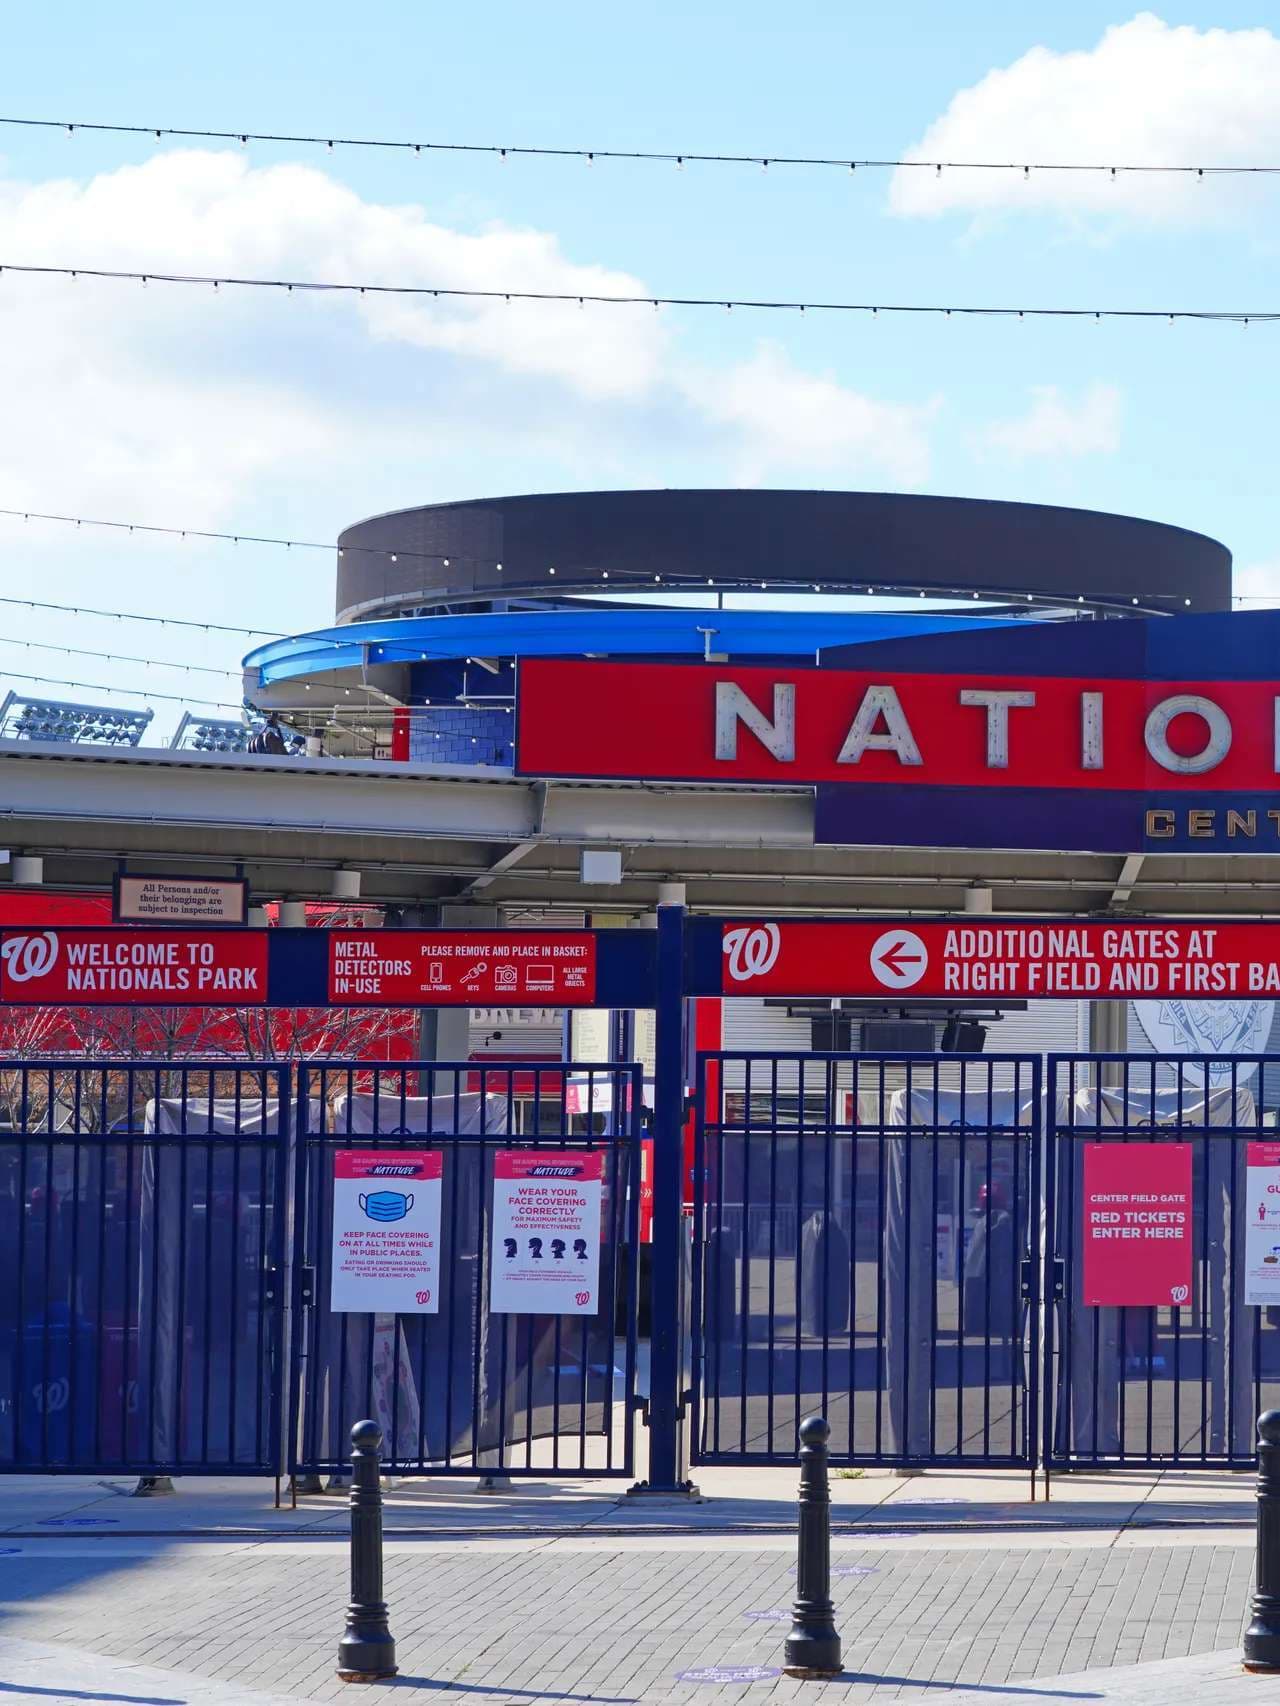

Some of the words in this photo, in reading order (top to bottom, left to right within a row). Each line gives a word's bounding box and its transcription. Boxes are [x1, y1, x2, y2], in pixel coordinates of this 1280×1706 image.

[143, 884, 155, 892] All
[158, 885, 191, 893] Persons
[193, 886, 220, 895] and/or
[140, 894, 160, 902] their
[162, 895, 206, 905] belongings
[138, 905, 168, 914] subject
[181, 906, 223, 915] inspection
[335, 941, 378, 957] METAL
[421, 945, 453, 956] PLEASE
[455, 945, 490, 956] REMOVE
[492, 945, 509, 956] AND
[512, 945, 539, 956] PLACE
[542, 945, 551, 956] IN
[553, 945, 588, 956] BASKET:
[943, 930, 1094, 958] ADDITIONAL
[1104, 930, 1179, 959] GATES
[1188, 930, 1217, 958] AT
[1, 931, 59, 982] W
[66, 943, 179, 965] WELCOME
[186, 943, 214, 965] TO
[722, 923, 780, 981] W
[335, 960, 412, 976] DETECTORS
[67, 967, 190, 990] NATIONALS
[198, 967, 258, 990] PARK
[943, 963, 1020, 991] RIGHT
[1028, 963, 1100, 991] FIELD
[1109, 963, 1159, 991] AND
[1169, 963, 1240, 991] FIRST
[335, 978, 381, 994] IN-USE
[373, 1166, 415, 1175] NATITUDE
[533, 1167, 576, 1176] NATITUDE
[518, 1188, 548, 1196] WEAR
[550, 1188, 577, 1196] YOUR
[1090, 1194, 1128, 1202] CENTER
[1131, 1194, 1158, 1202] FIELD
[1160, 1194, 1186, 1202] GATE
[508, 1197, 533, 1205] FACE
[536, 1198, 586, 1206] COVERING
[518, 1207, 576, 1215] CORRECTLY
[1091, 1212, 1120, 1223] RED
[1124, 1212, 1186, 1223] TICKETS
[1092, 1227, 1141, 1239] ENTER
[1144, 1227, 1184, 1239] HERE
[416, 1289, 431, 1305] W
[575, 1291, 590, 1306] W
[1171, 1285, 1188, 1303] W
